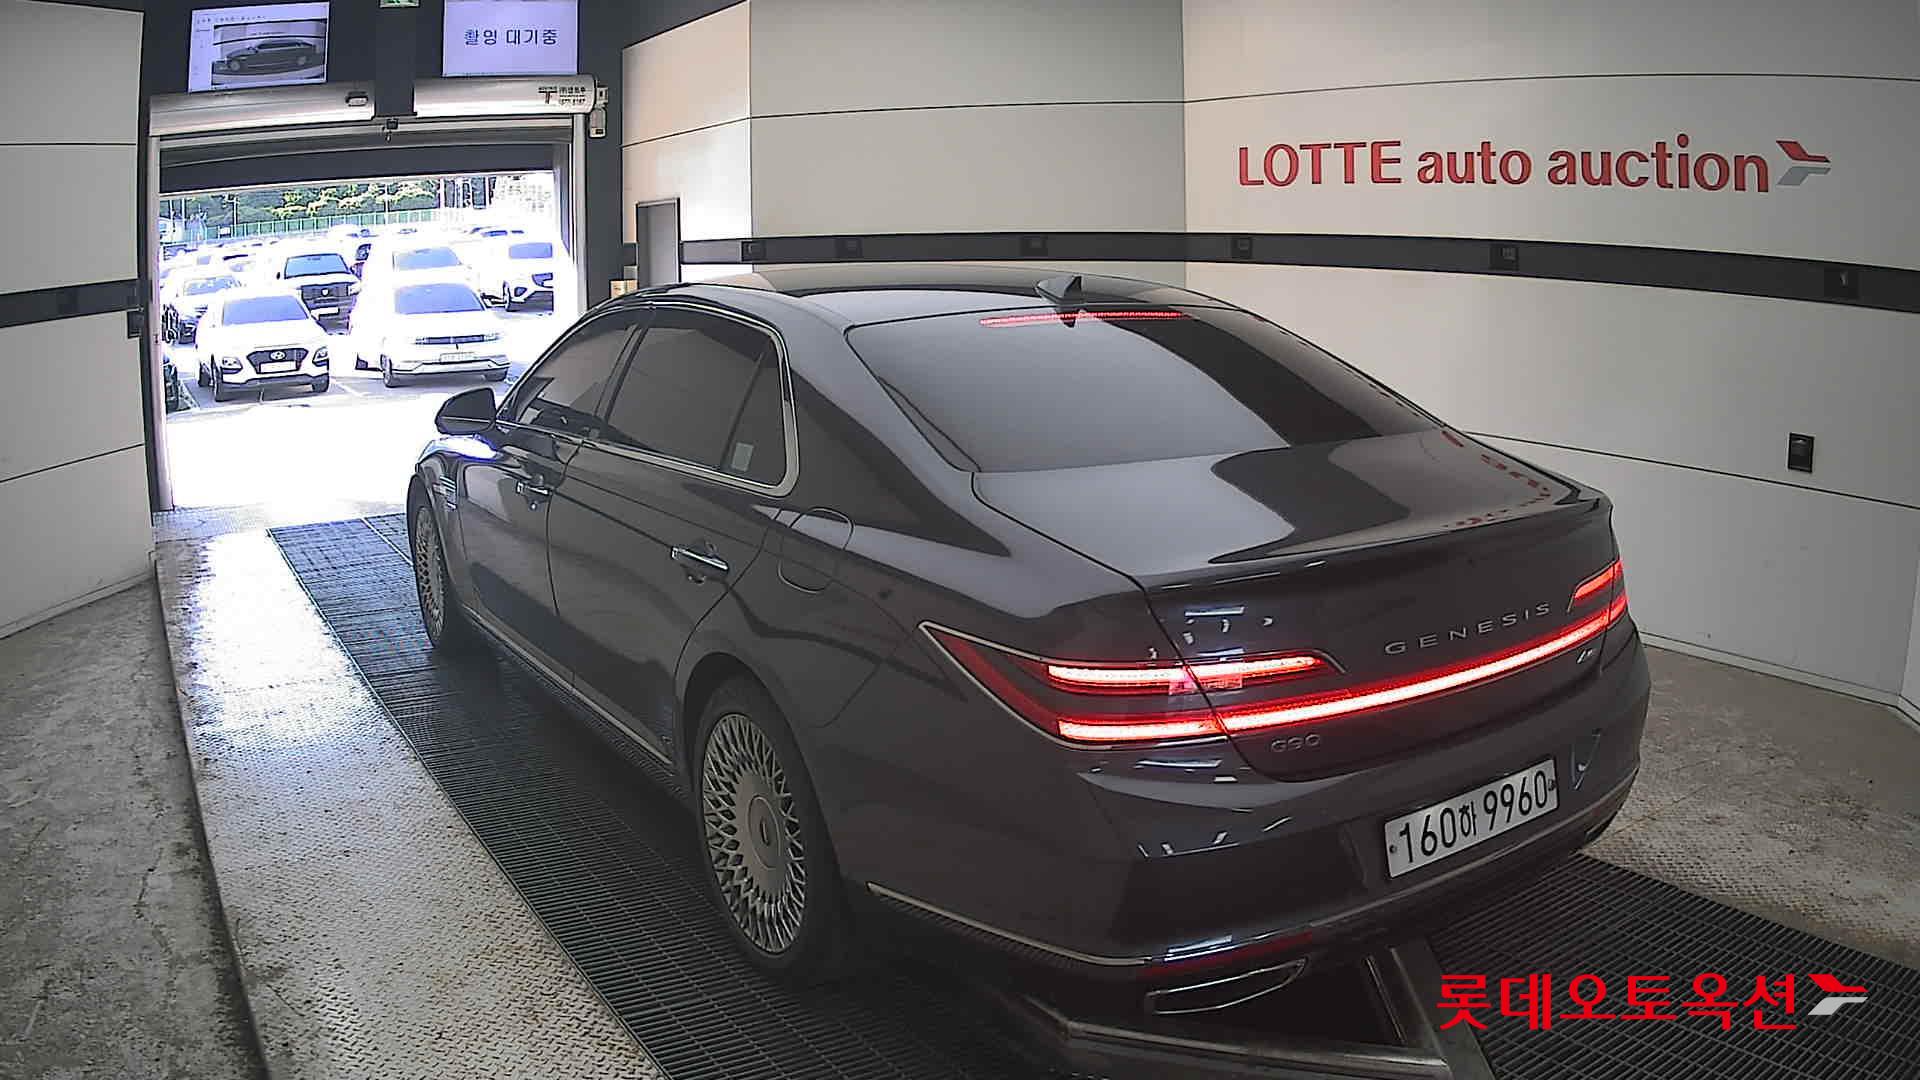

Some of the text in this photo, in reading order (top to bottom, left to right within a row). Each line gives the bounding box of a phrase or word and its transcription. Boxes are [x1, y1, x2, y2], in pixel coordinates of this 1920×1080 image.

[506, 29, 557, 45] 대기중
[1239, 133, 1769, 192] LOTTE auto auction
[1384, 603, 1550, 655] GENESIS
[1271, 734, 1320, 752] G90
[1483, 770, 1548, 831] 9960
